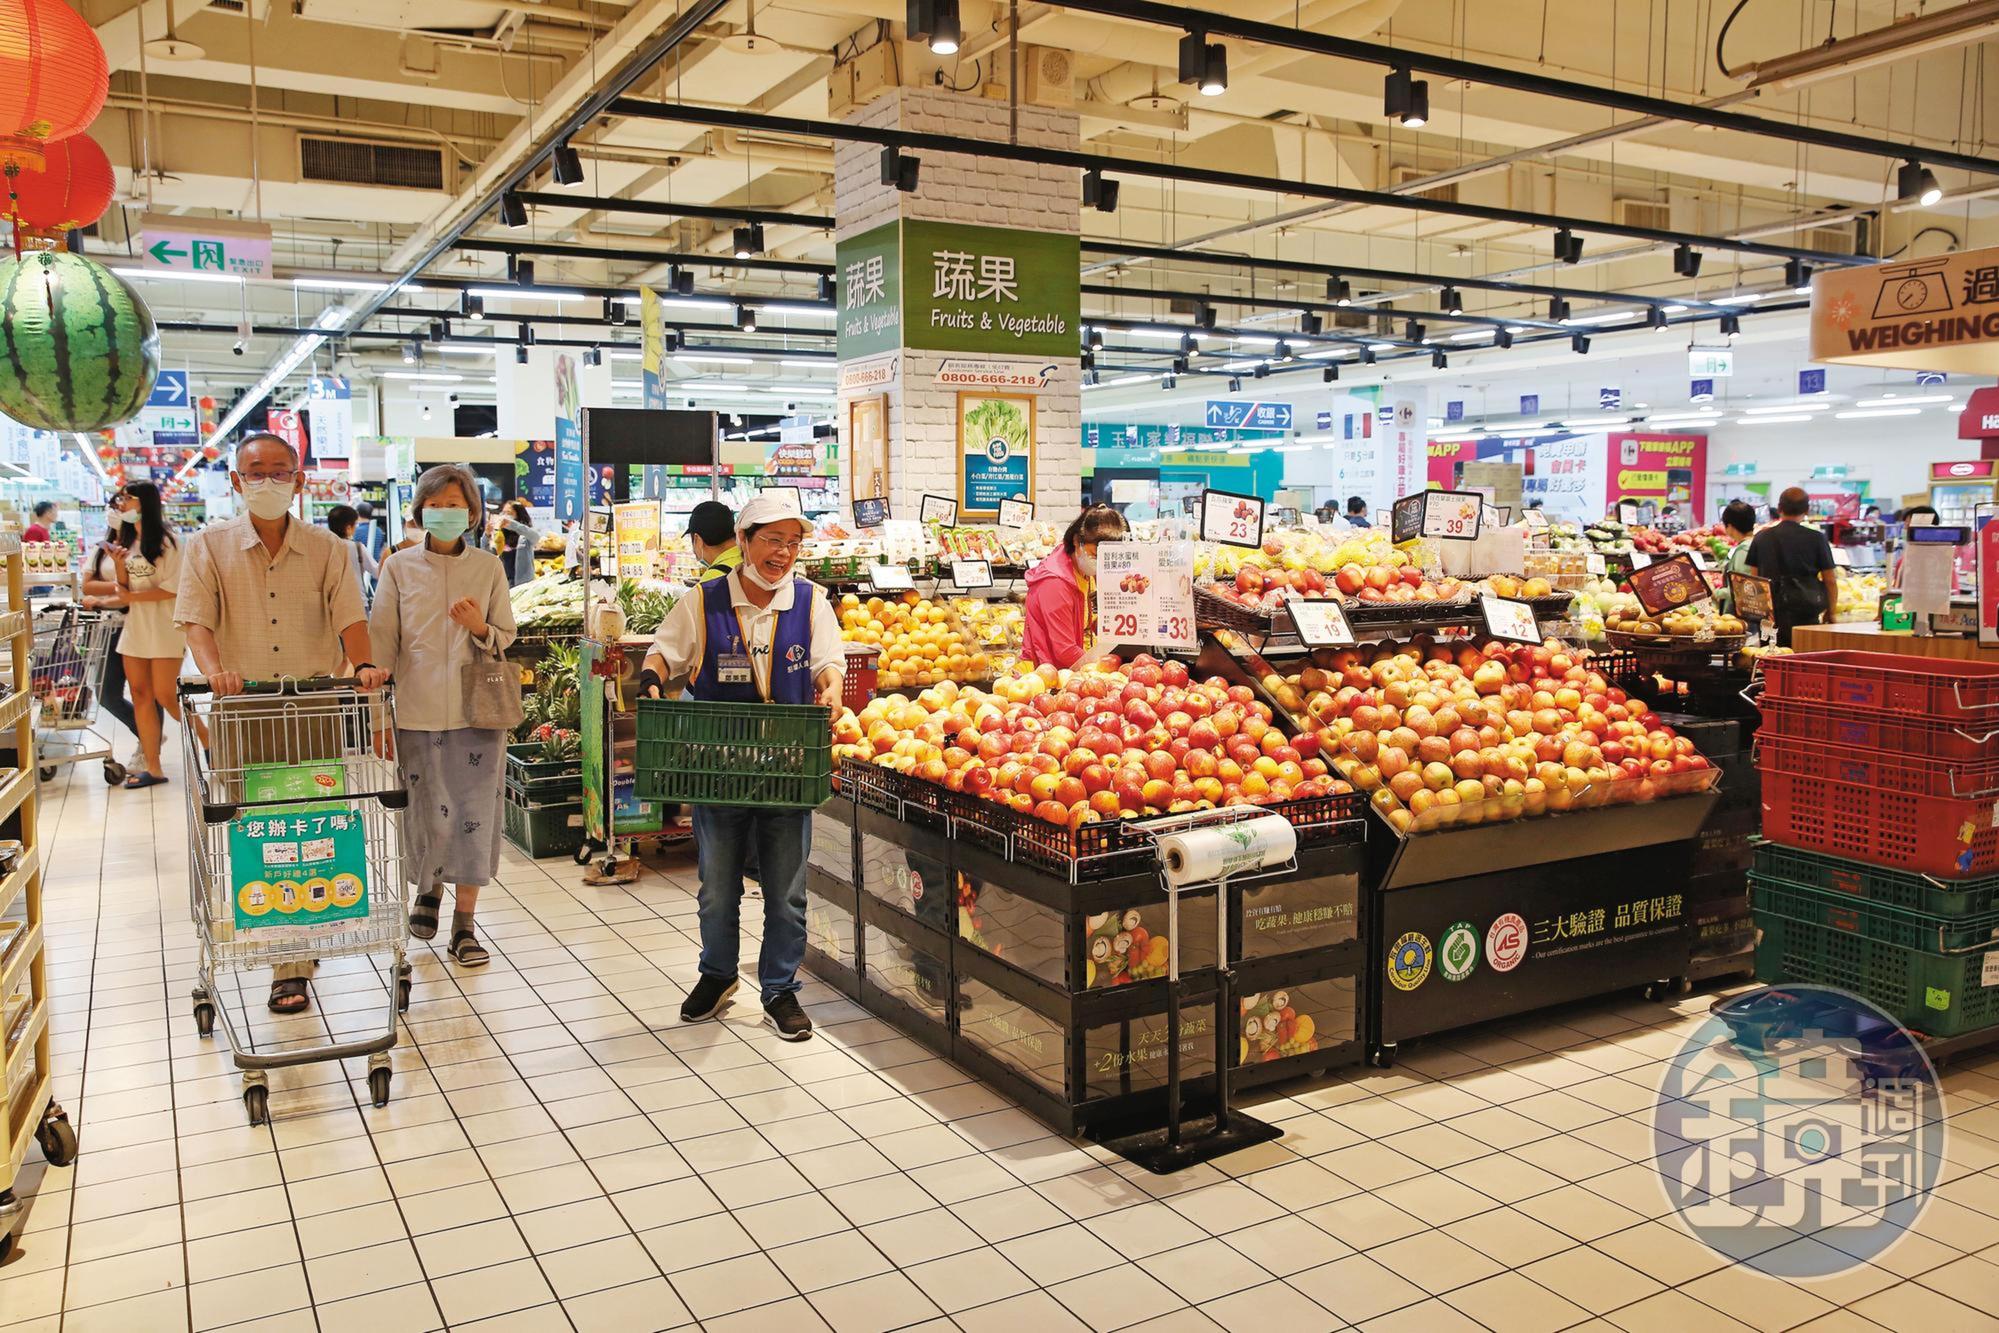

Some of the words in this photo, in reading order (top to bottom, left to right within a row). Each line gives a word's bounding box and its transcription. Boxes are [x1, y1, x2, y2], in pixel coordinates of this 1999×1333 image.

[232, 266, 262, 274] EXIT
[932, 250, 1019, 303] 蔬果
[845, 255, 885, 311] 蔬果
[845, 316, 862, 338] Fruits
[870, 305, 899, 336] Vegetable
[931, 309, 975, 329] Fruits
[980, 311, 993, 330] &
[998, 313, 1066, 338] Vegetable
[1848, 312, 1999, 351] WEIGHING
[845, 368, 886, 385] 0800-666-218
[941, 373, 1036, 385] 0800-666-218
[310, 379, 337, 399] 3M
[1257, 407, 1275, 419] 收銀
[1229, 522, 1247, 538] 23
[1446, 519, 1463, 534] 39
[1114, 614, 1137, 636] 29
[1169, 616, 1188, 640] 33
[1324, 623, 1341, 637] 19
[1511, 623, 1529, 637] 12
[1450, 922, 1472, 932] TAP
[1532, 908, 1606, 944] 三大驗證
[1614, 894, 1683, 929] 品質保證
[1493, 953, 1521, 969] ORGANIC
[1389, 967, 1407, 989] Carrefour
[1408, 973, 1426, 989] Quality
